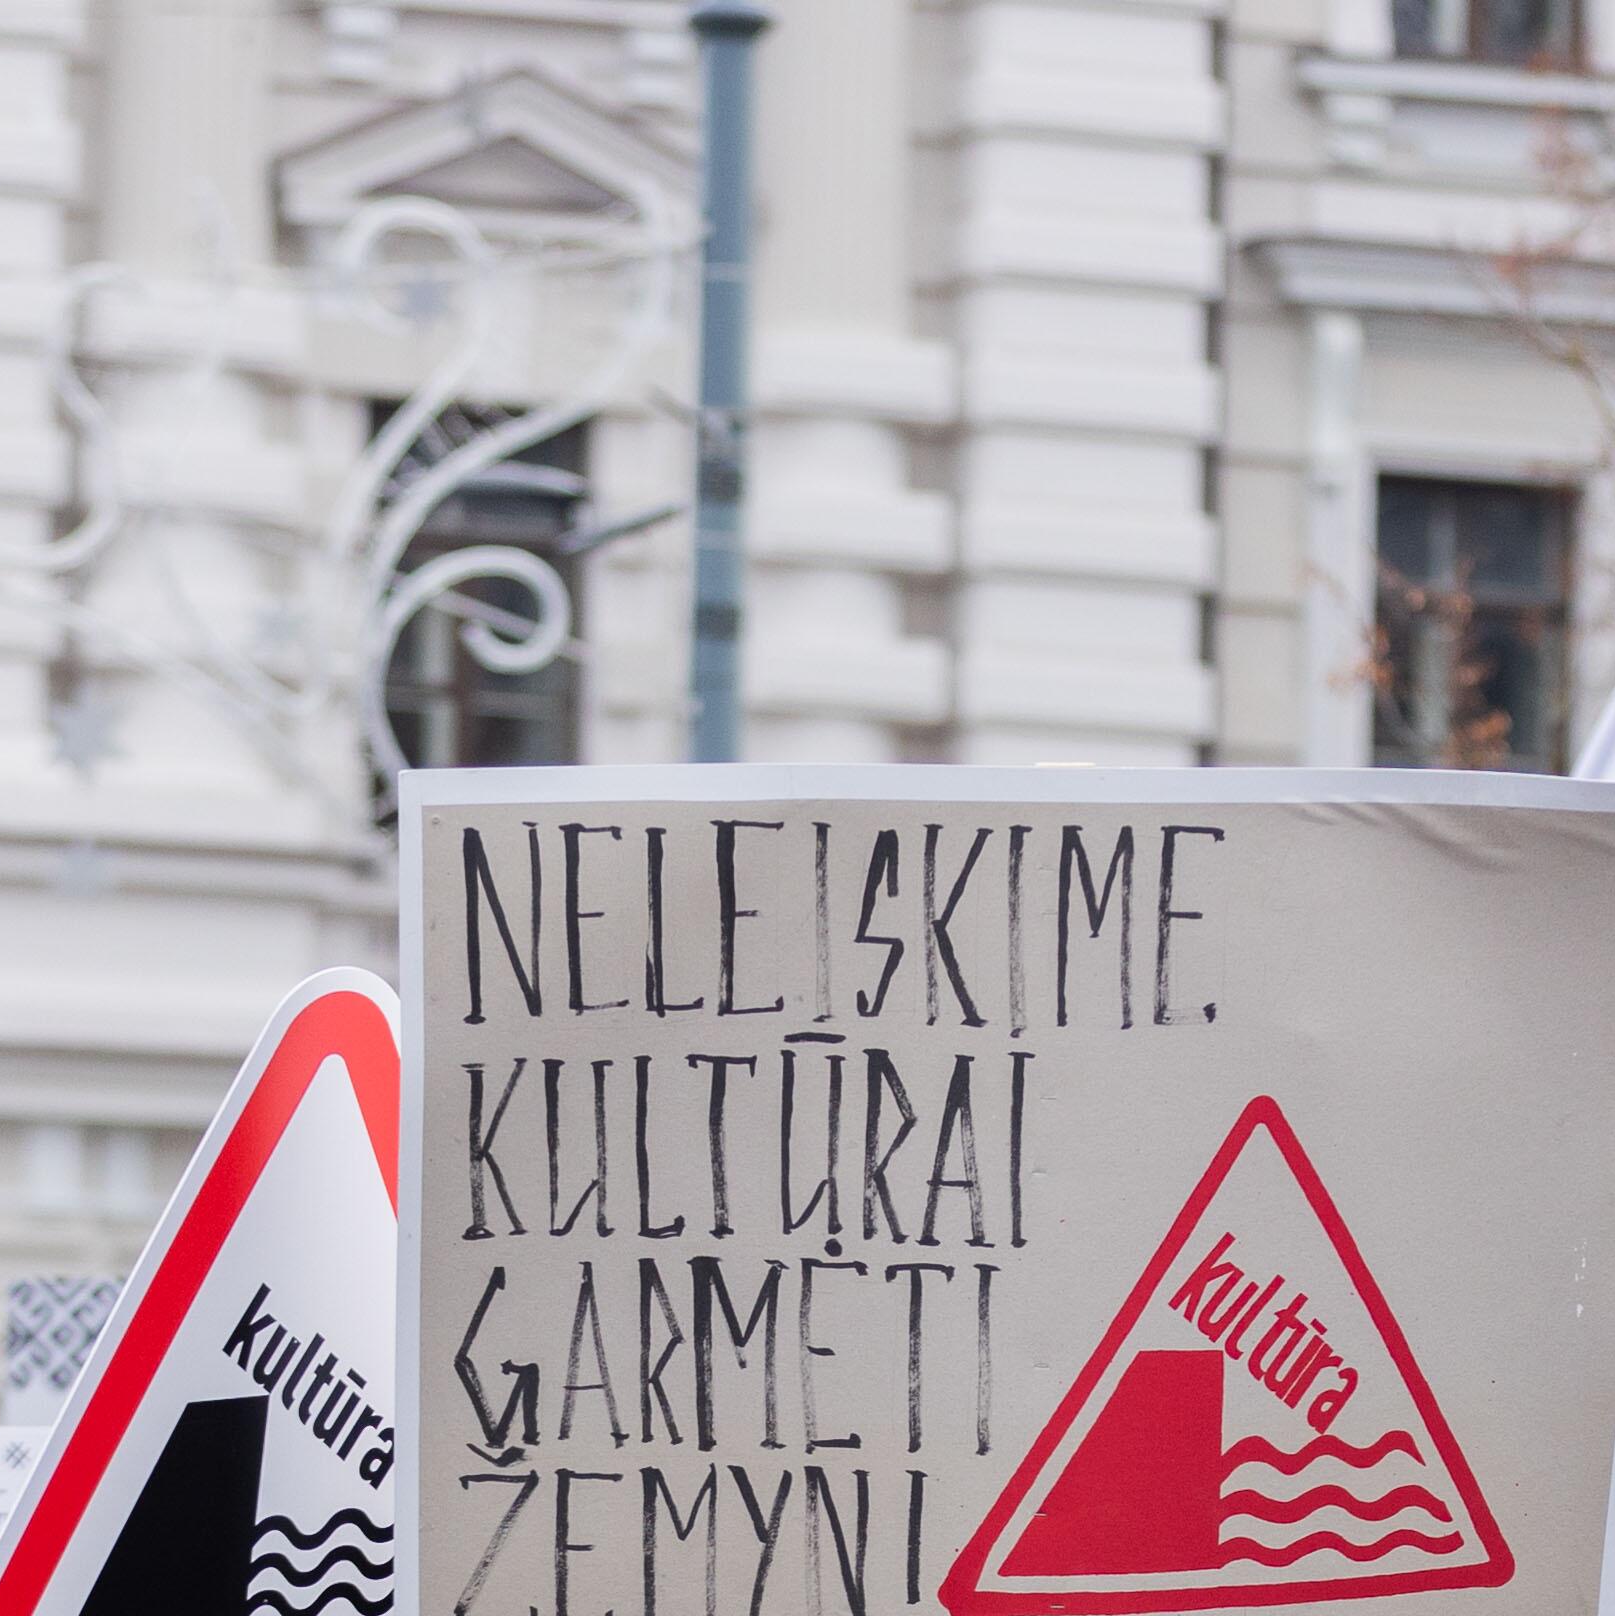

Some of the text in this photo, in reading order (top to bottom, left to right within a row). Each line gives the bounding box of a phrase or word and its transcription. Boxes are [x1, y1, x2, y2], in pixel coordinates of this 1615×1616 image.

[460, 1032, 1036, 1248] KULTŪRAI
[222, 1282, 395, 1490] kultūra
[455, 1239, 1001, 1456] GARMĖTI
[1168, 1231, 1359, 1435] kultūra
